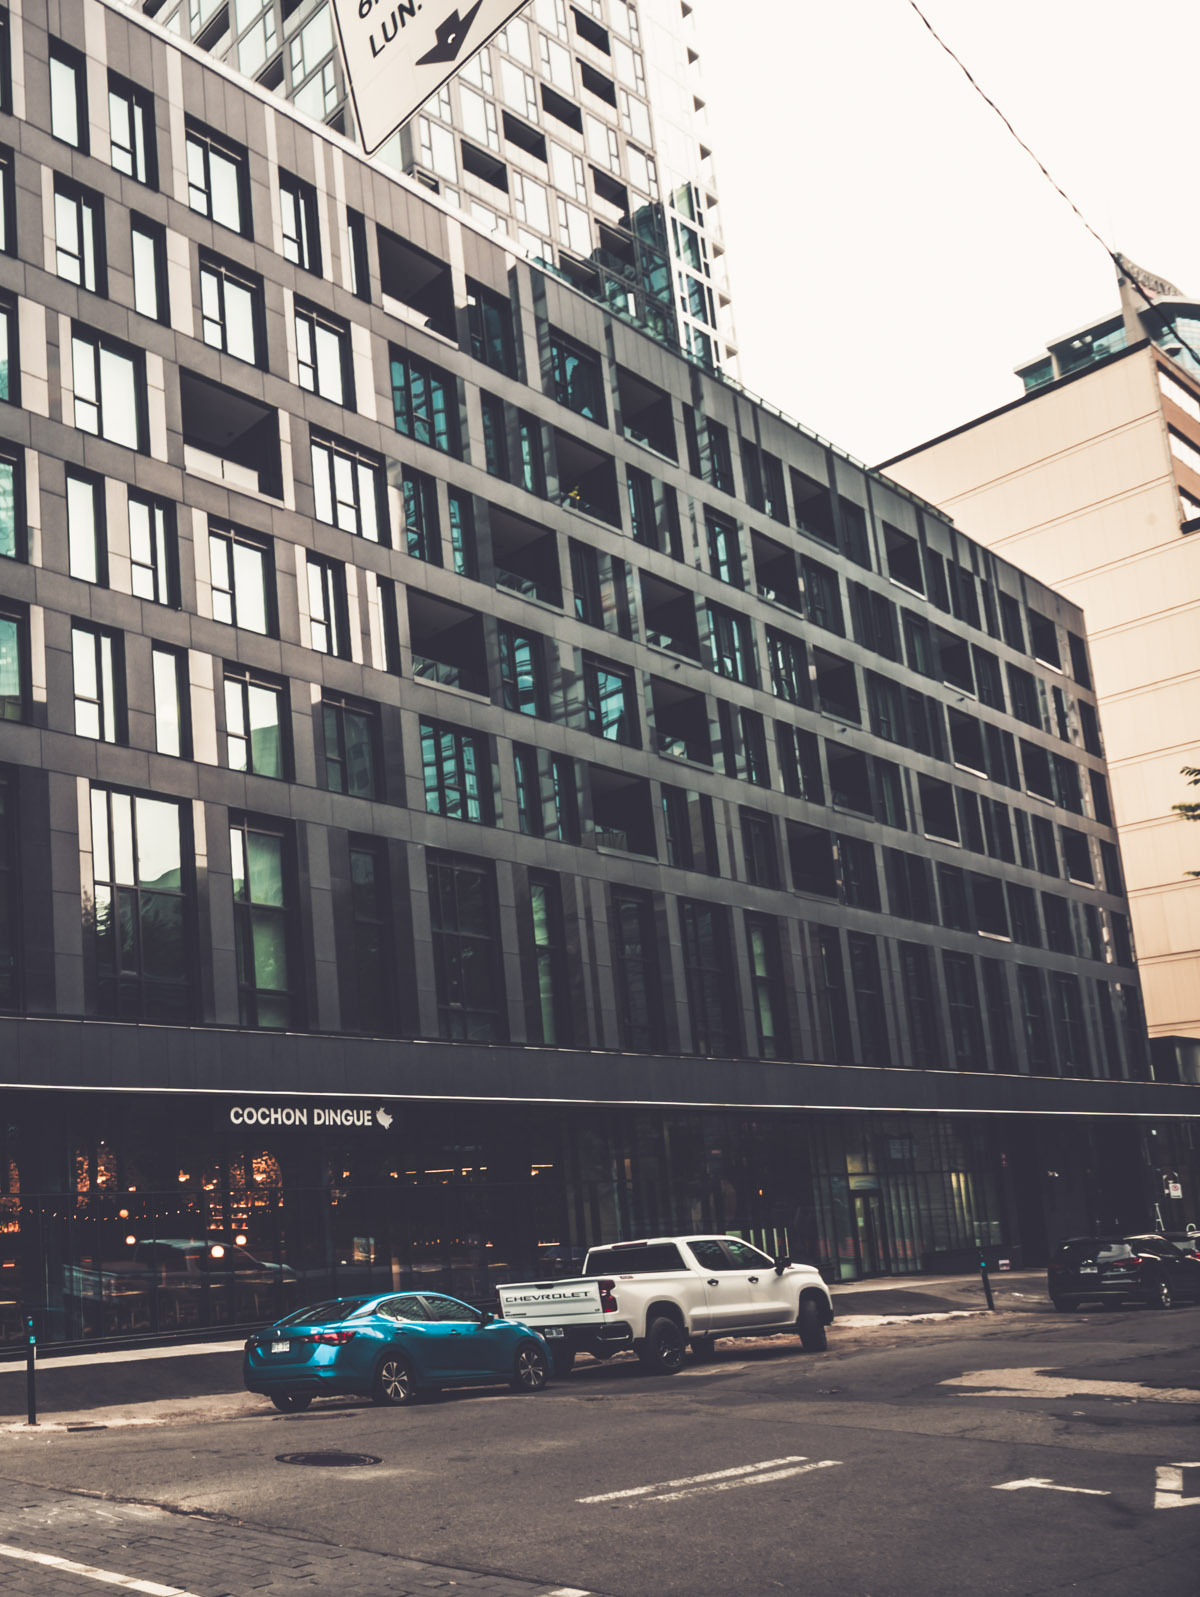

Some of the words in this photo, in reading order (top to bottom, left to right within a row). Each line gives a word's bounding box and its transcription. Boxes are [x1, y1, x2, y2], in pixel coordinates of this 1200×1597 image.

[369, 0, 423, 58] LUN.
[229, 1106, 308, 1126] COCHON
[313, 1109, 373, 1127] DINGUE
[505, 1290, 591, 1303] CHEVROLET
